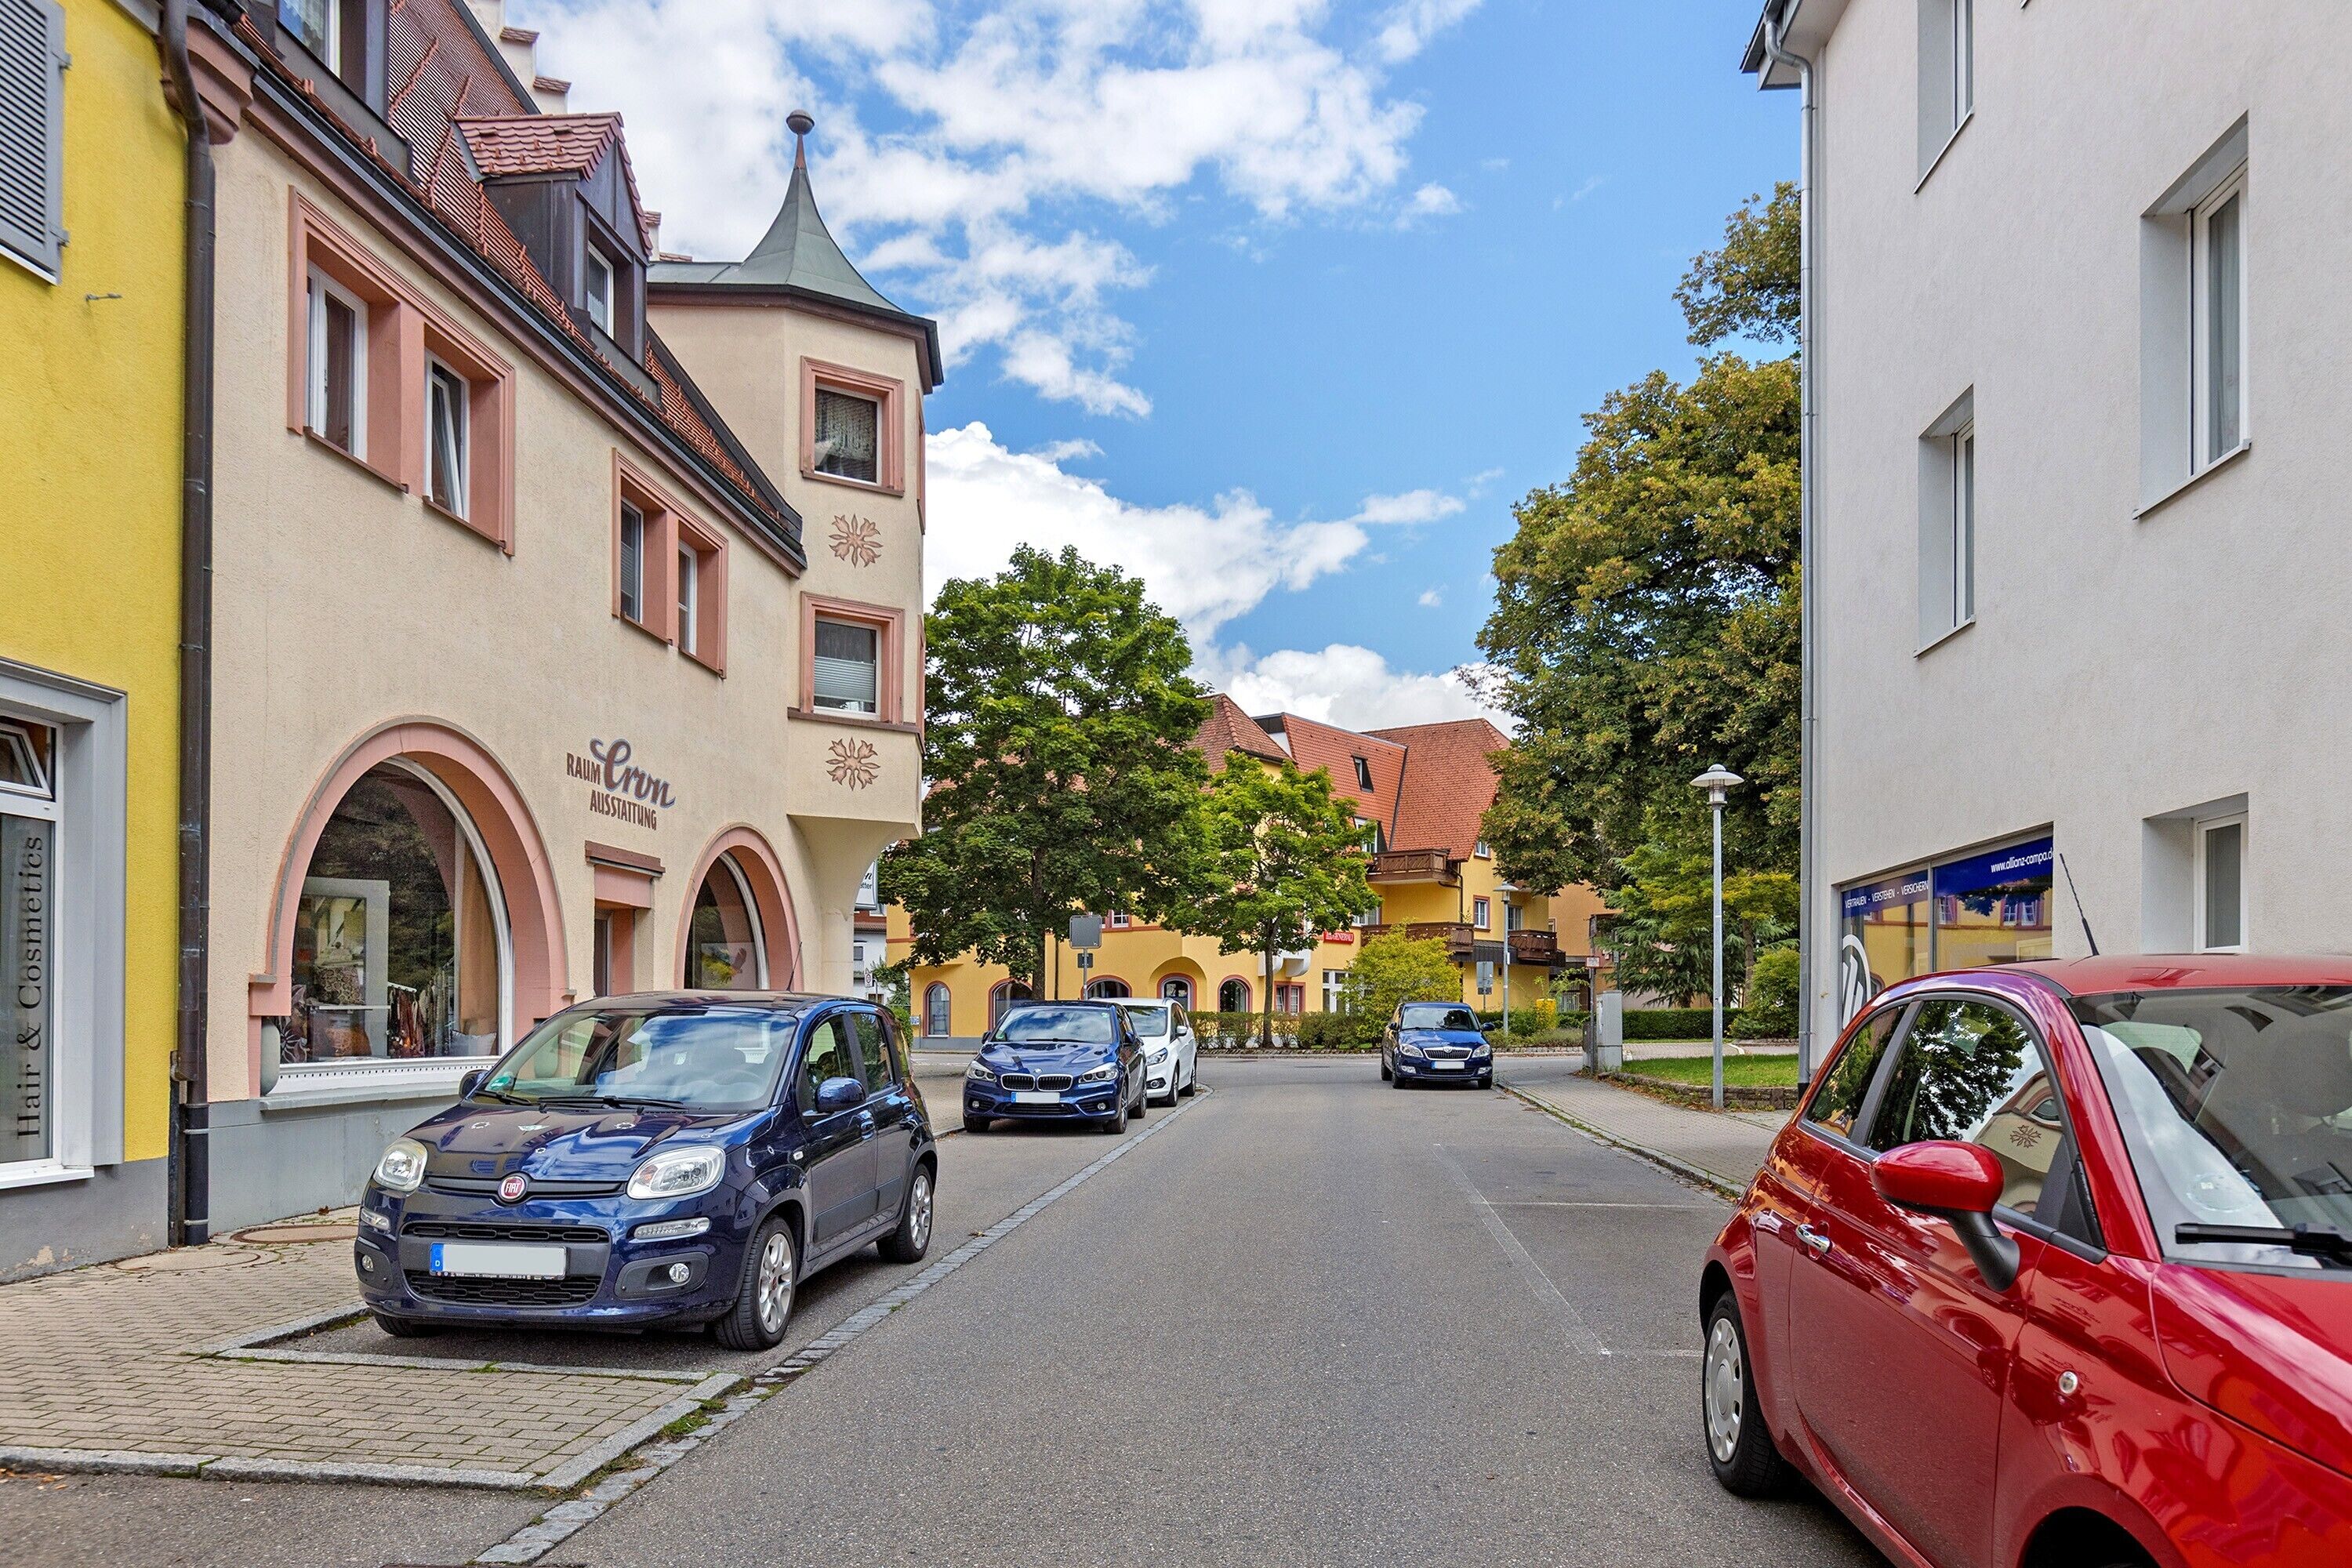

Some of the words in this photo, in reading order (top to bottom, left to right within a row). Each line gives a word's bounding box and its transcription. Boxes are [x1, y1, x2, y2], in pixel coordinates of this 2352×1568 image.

[566, 752, 601, 785] RAUM
[590, 789, 657, 831] AUSSTATTUNG
[1991, 847, 2053, 873] www.allianz-campa.d
[1871, 887, 1896, 902] VERSTEHEN
[18, 836, 43, 1010] Cosmetics
[16, 1022, 42, 1051] &
[16, 1063, 42, 1140] Hair
[505, 1182, 521, 1193] FIAT
